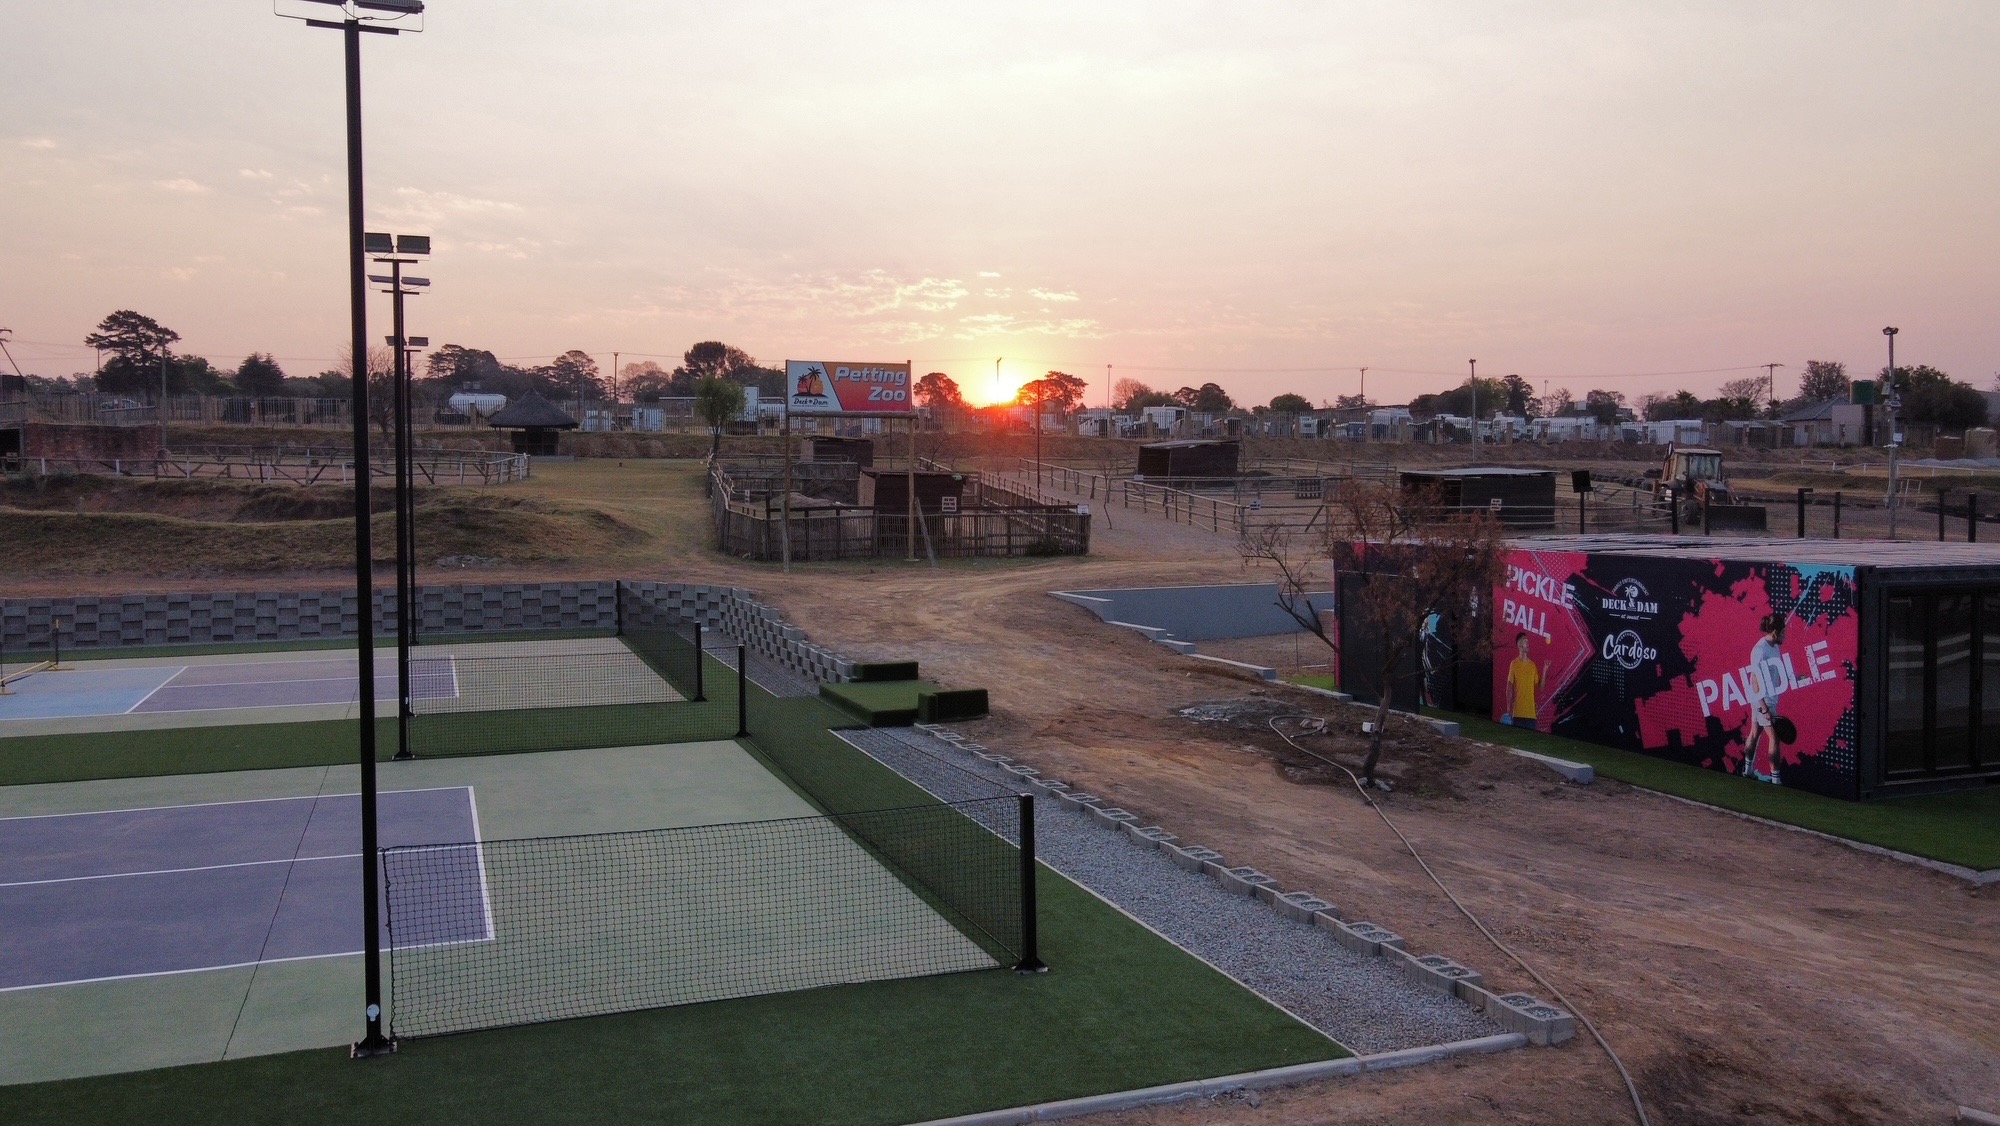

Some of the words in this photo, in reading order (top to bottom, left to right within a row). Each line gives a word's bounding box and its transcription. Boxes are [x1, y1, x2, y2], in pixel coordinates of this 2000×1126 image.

[835, 367, 907, 386] Petting
[868, 387, 906, 402] Zoo
[1506, 564, 1576, 610] PICKLE
[1502, 598, 1551, 639] BALL
[1602, 598, 1627, 611] DECK
[1637, 601, 1658, 614] DAM
[1603, 634, 1657, 660] Cardoso
[1696, 640, 1837, 718] PADDLE
